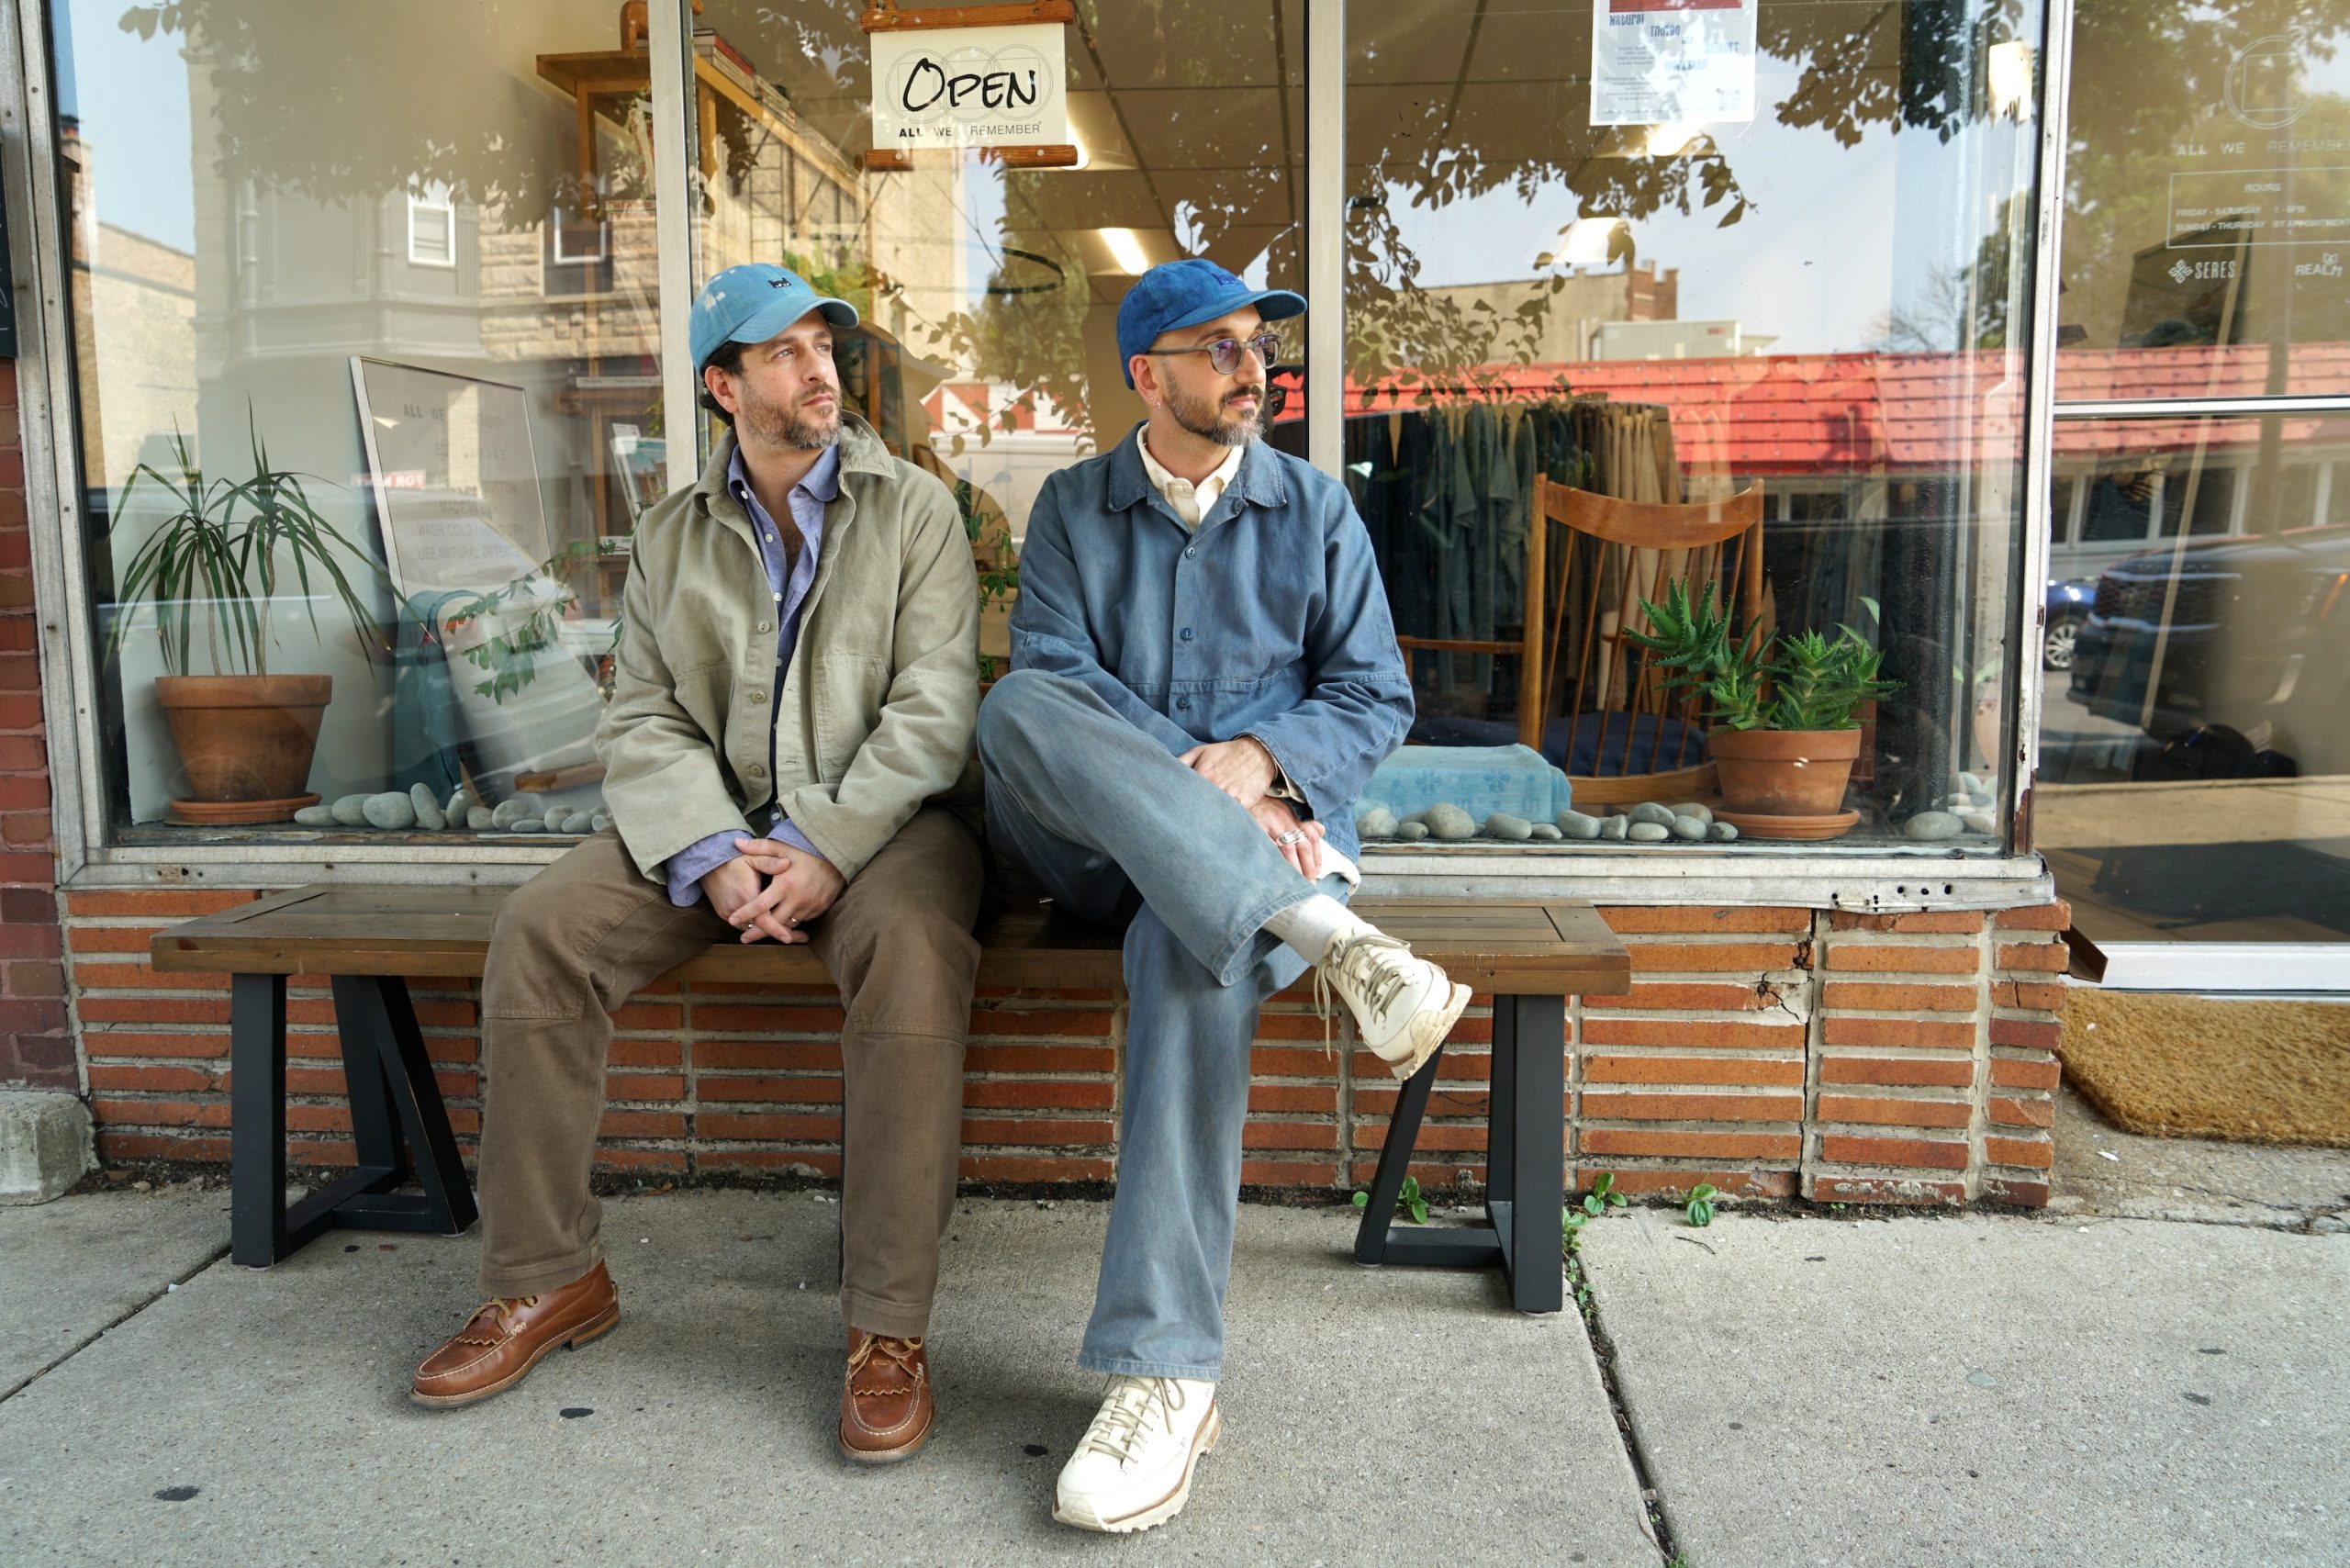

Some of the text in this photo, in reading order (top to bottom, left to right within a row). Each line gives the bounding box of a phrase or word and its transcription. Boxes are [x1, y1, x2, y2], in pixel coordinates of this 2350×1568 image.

[1609, 14, 1645, 27] Natural
[899, 124, 1040, 138] ALL WE REMEMBER
[2176, 140, 2350, 156] ALL WE REMEMBE
[2176, 208, 2209, 218] FRIDAY
[2175, 223, 2211, 232] SUNDAY
[2218, 220, 2266, 230] THURSDAY
[2194, 260, 2237, 280] SERES
[2294, 263, 2344, 277] REALM
[403, 403, 423, 419] ALL
[429, 407, 446, 422] WE
[418, 523, 444, 537] WASH
[447, 523, 472, 537] COLD
[418, 544, 531, 560] USE NATURAL DETERT
